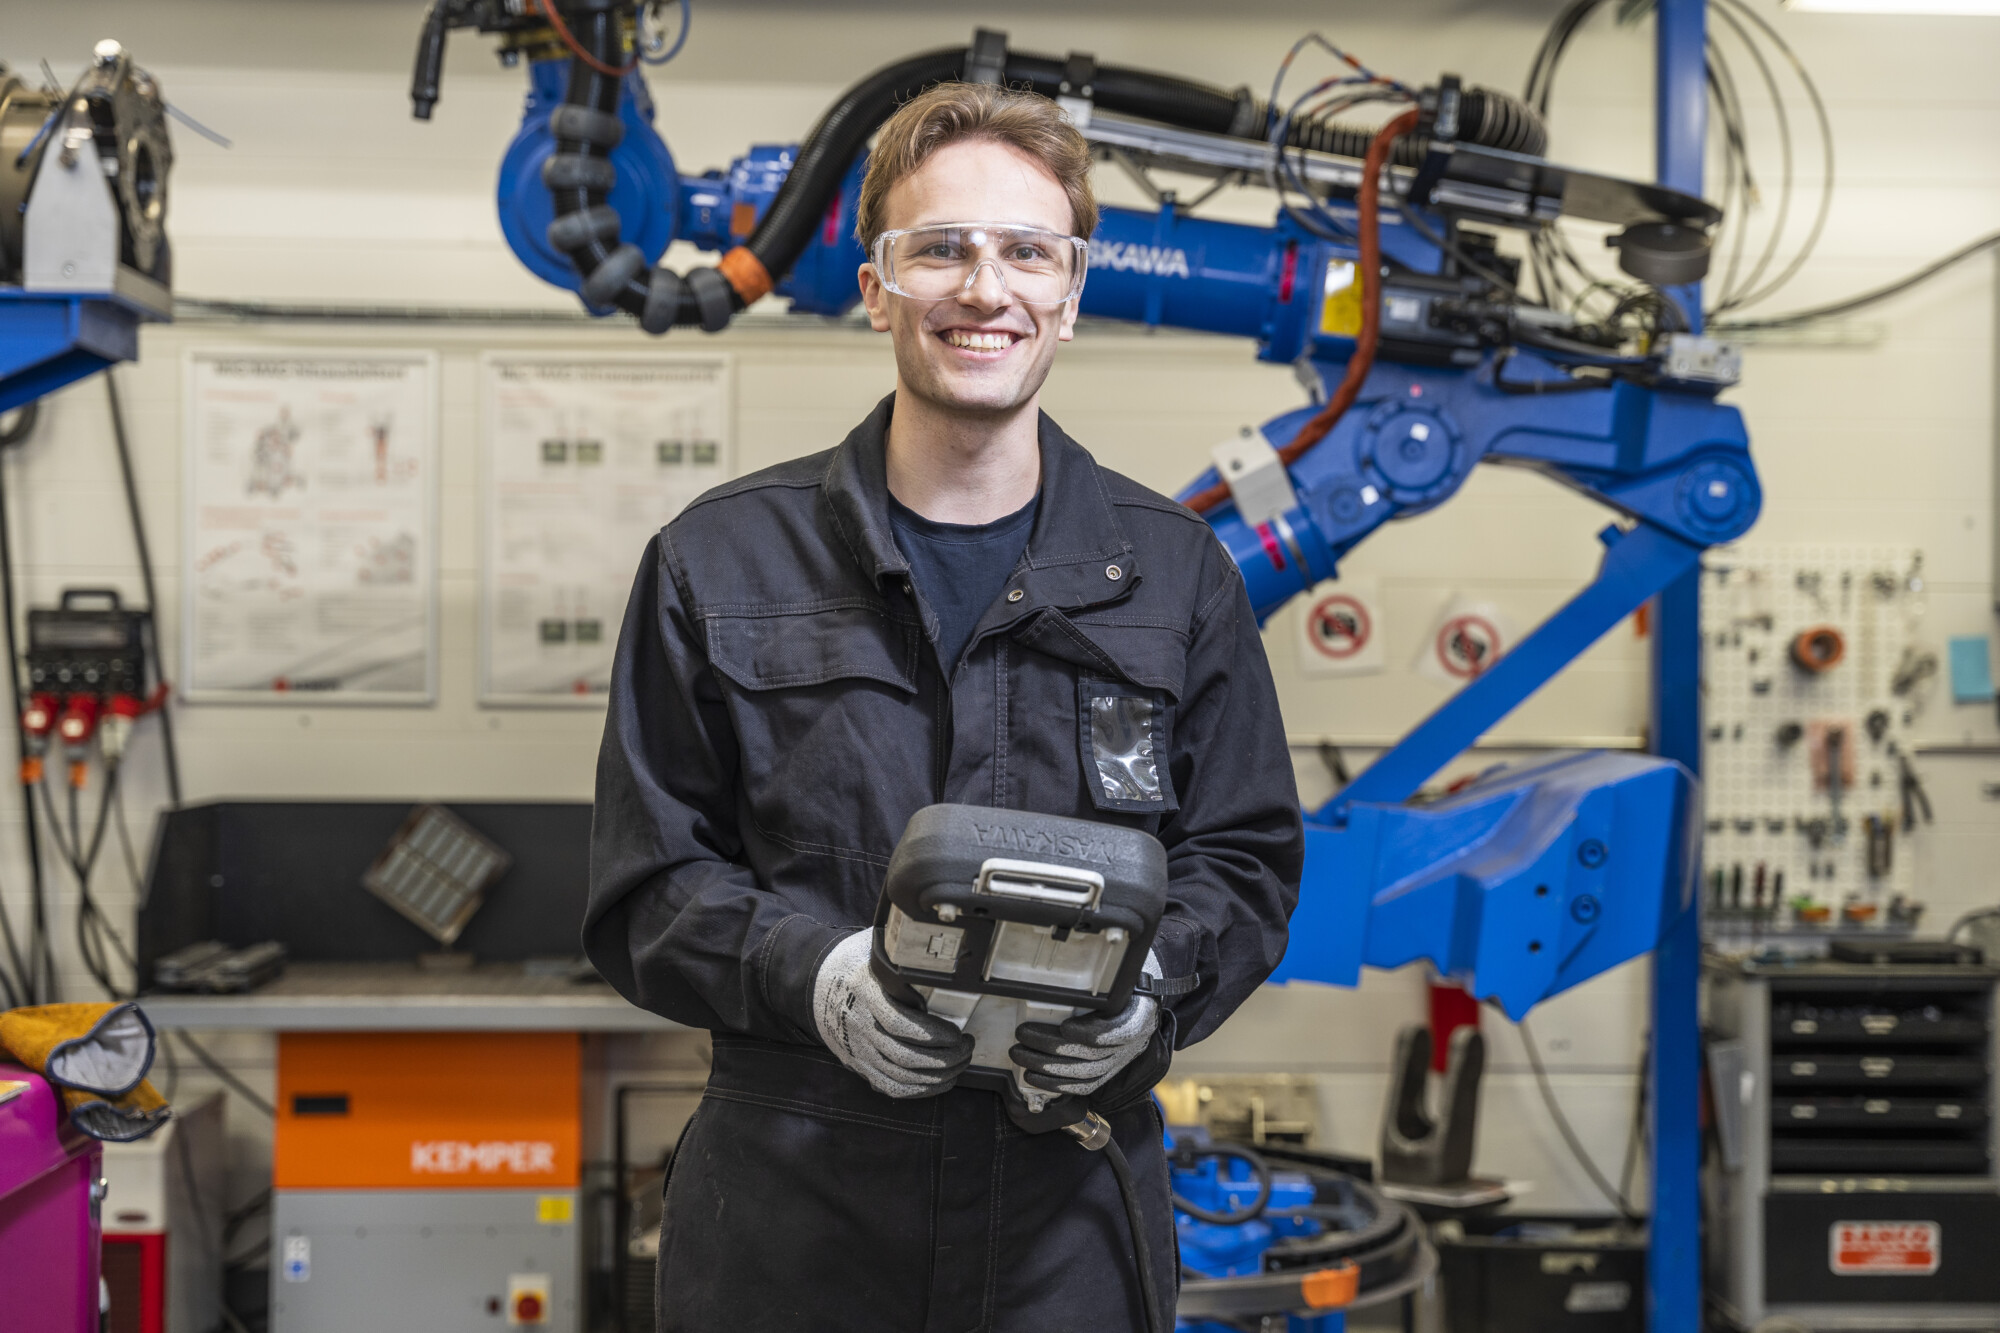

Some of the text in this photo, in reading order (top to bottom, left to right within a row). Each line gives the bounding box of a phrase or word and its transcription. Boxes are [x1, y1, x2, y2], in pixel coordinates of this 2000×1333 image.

[1087, 238, 1190, 279] SKAWA
[973, 822, 1113, 865] YASKAWA
[411, 1141, 555, 1174] KEMPER
